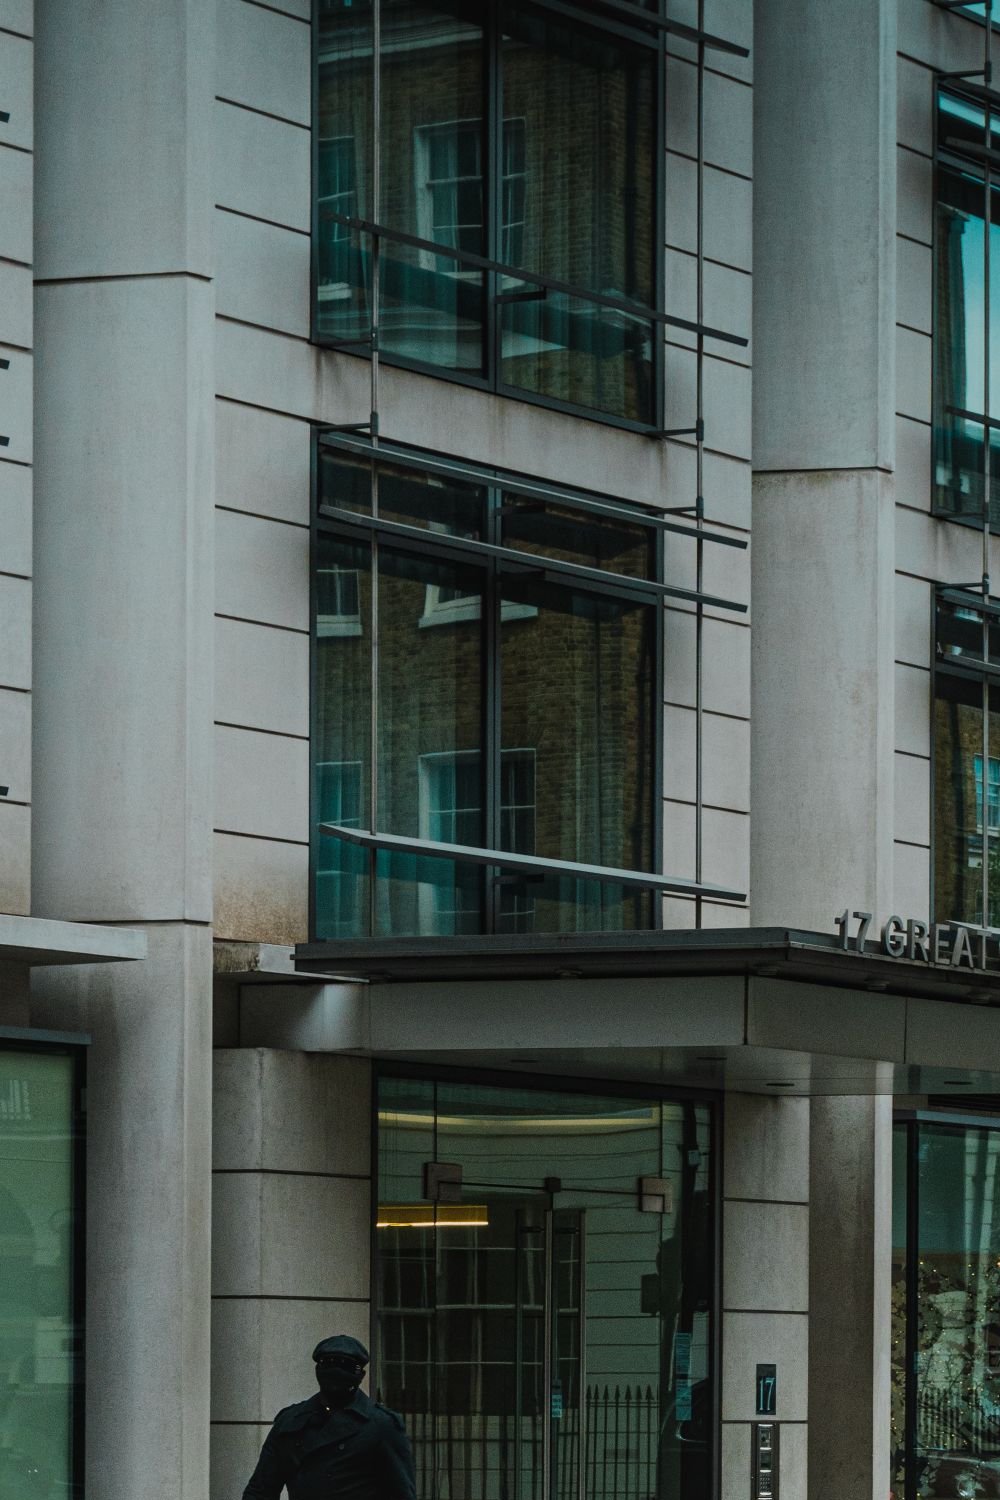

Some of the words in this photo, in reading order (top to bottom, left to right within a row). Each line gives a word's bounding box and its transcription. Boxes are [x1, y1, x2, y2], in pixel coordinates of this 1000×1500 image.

[835, 909, 872, 953] 17
[881, 915, 992, 970] GREAT
[759, 1377, 775, 1411] 17
